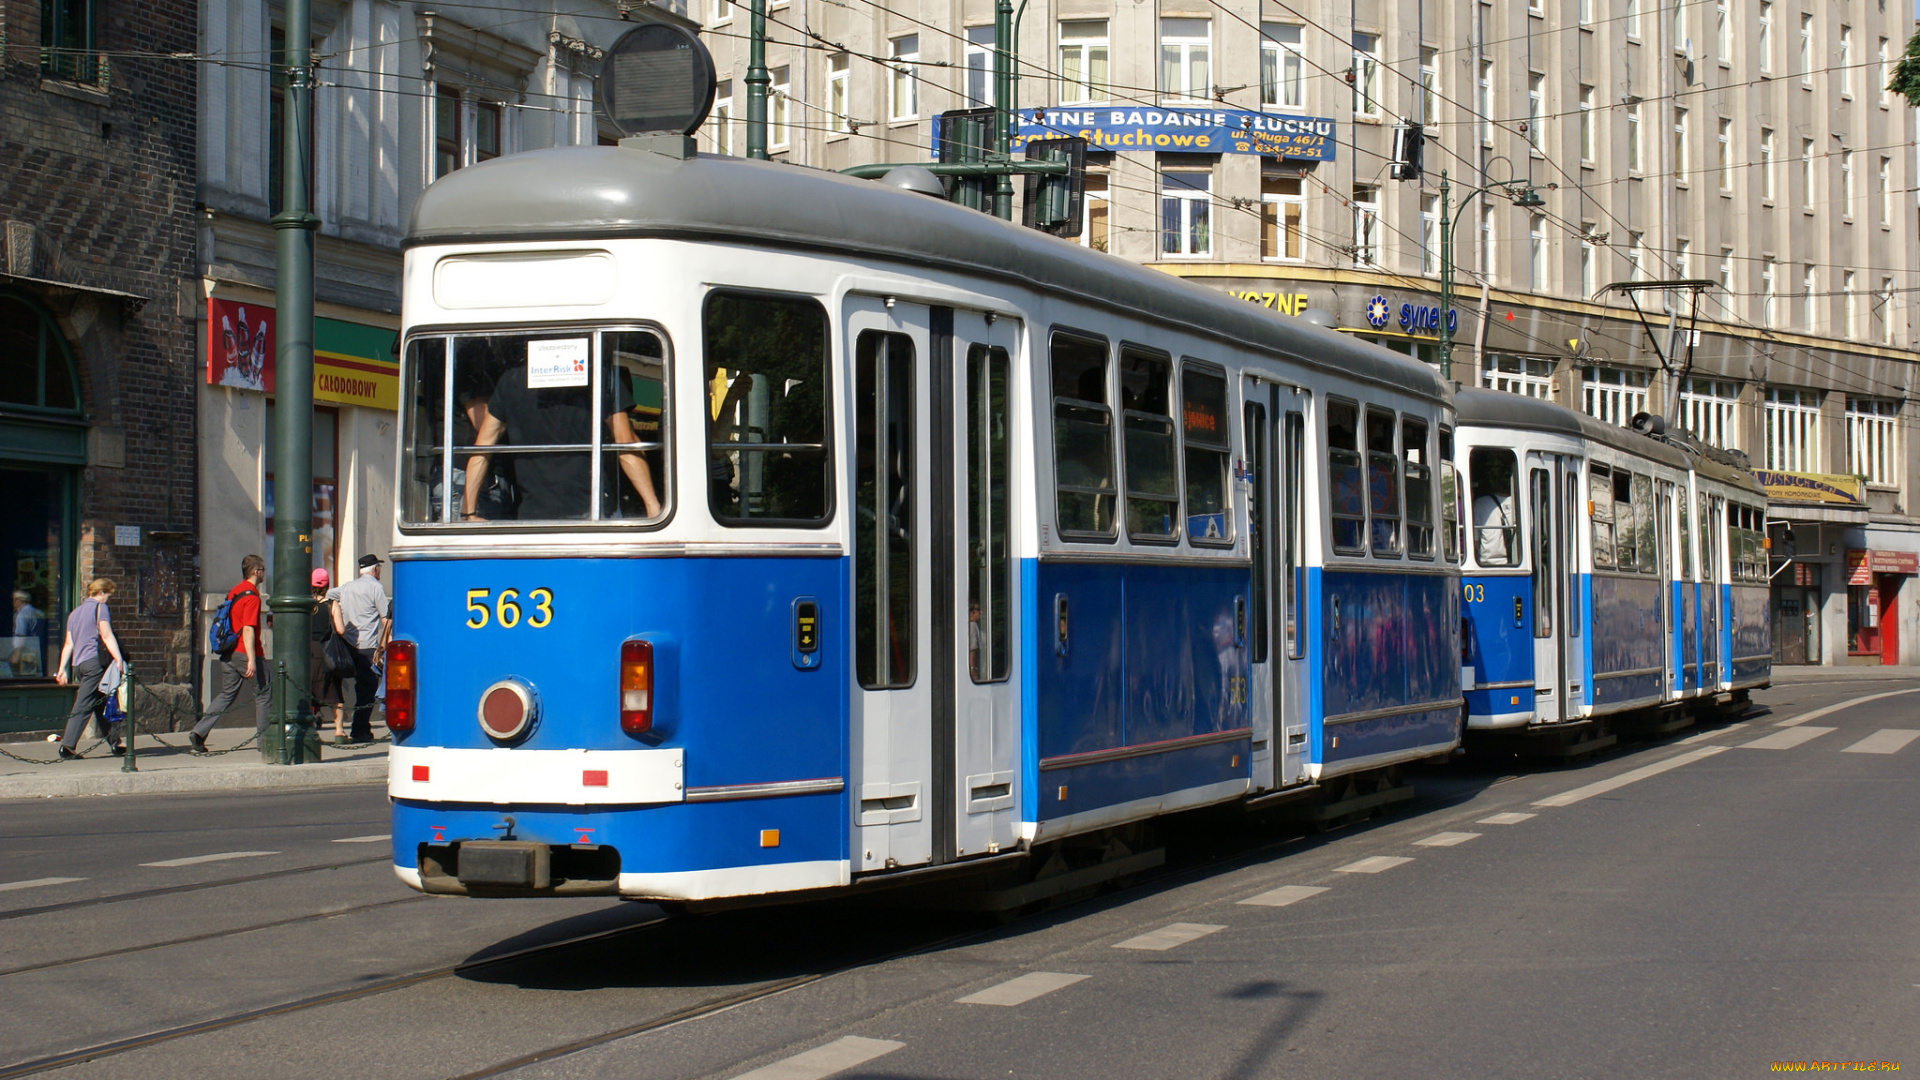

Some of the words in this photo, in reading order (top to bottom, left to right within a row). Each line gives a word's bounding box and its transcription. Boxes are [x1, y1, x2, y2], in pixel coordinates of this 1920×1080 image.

[1110, 111, 1226, 127] BADANIE
[1240, 115, 1330, 136] SŁUCHU
[1231, 130, 1247, 139] ul.
[1293, 135, 1325, 146] 46/1
[1254, 144, 1322, 158] 634-25-51
[1400, 303, 1457, 333] syneo
[531, 365, 571, 375] InterRisk
[319, 374, 377, 398] CAŁODOBOWY
[1464, 584, 1485, 602] 03
[466, 588, 553, 629] 563
